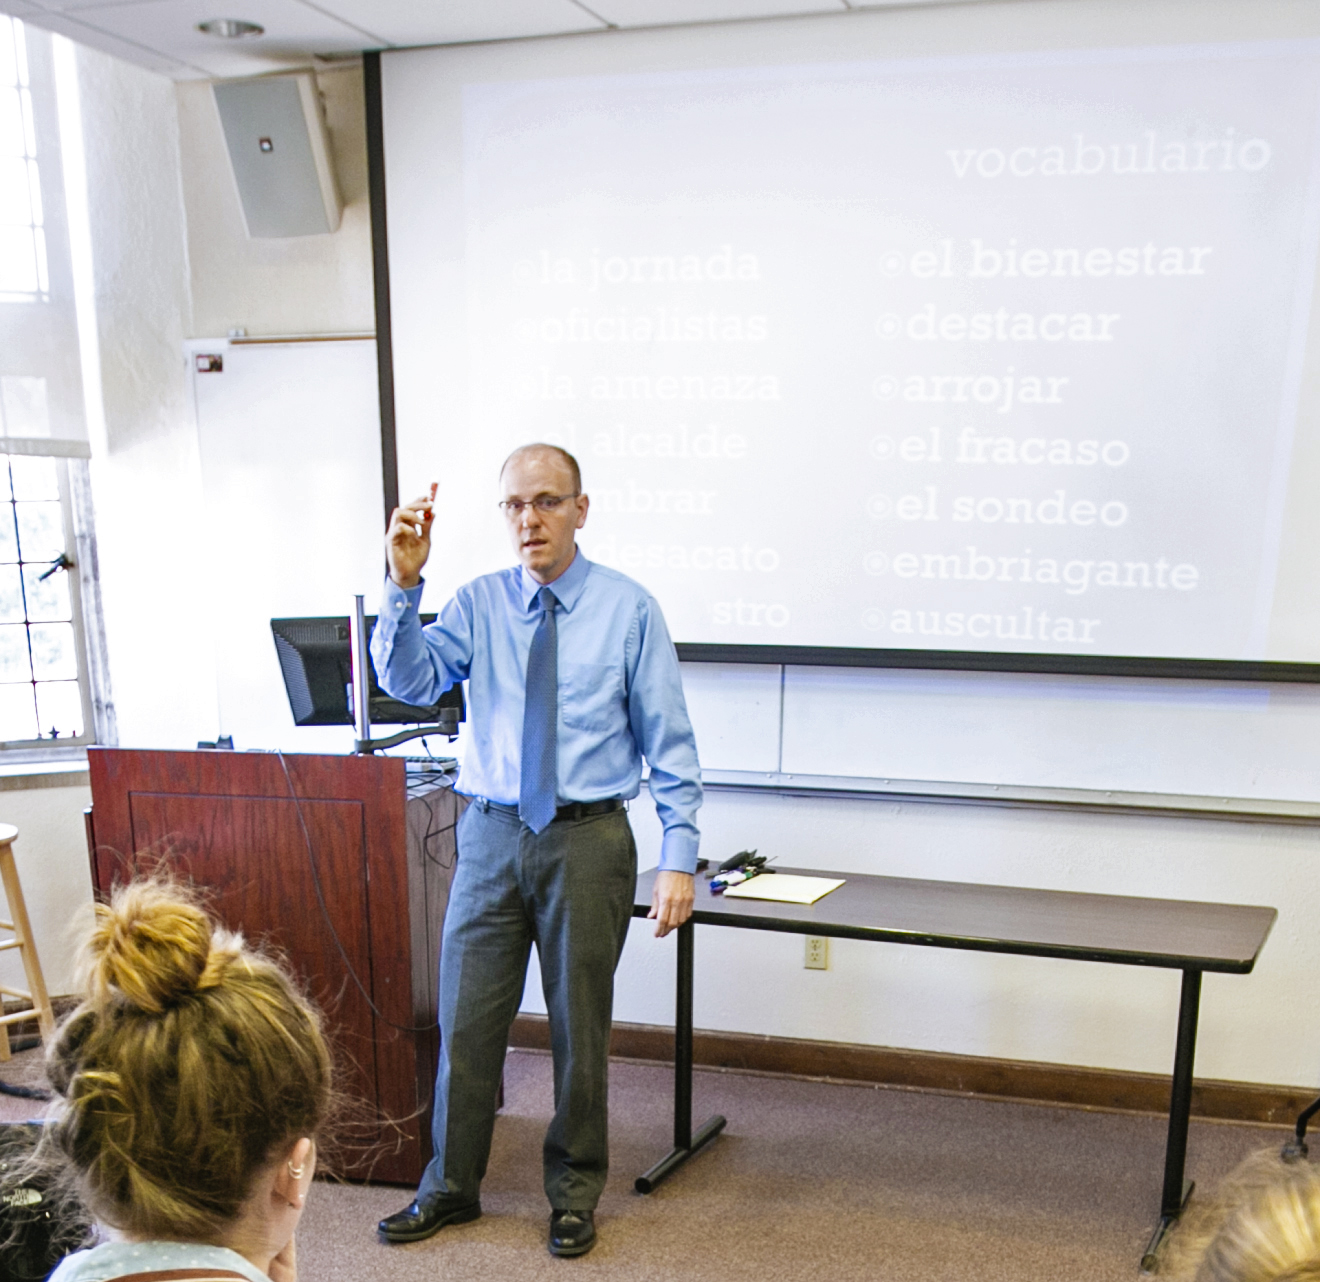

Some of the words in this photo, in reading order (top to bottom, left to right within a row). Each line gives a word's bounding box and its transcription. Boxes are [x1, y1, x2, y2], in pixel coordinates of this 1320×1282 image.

[946, 127, 1273, 179] vocabulario
[538, 248, 576, 284] la
[588, 244, 762, 292] jornada
[909, 237, 954, 278] el
[970, 238, 1213, 278] bienestar
[539, 307, 769, 344] oficialistas
[906, 302, 1122, 343] destacar
[539, 366, 576, 401] la
[590, 373, 782, 402] amenaza
[902, 365, 1070, 415] arrojar
[591, 423, 748, 459] alcalde
[898, 426, 941, 463] el
[956, 427, 1131, 468] fracaso
[587, 478, 718, 514] mbrar
[896, 485, 939, 522] el
[952, 489, 1128, 529] sondeo
[591, 535, 781, 573] desacato
[892, 544, 1200, 596] embriagante
[889, 604, 1101, 646] auscultar
